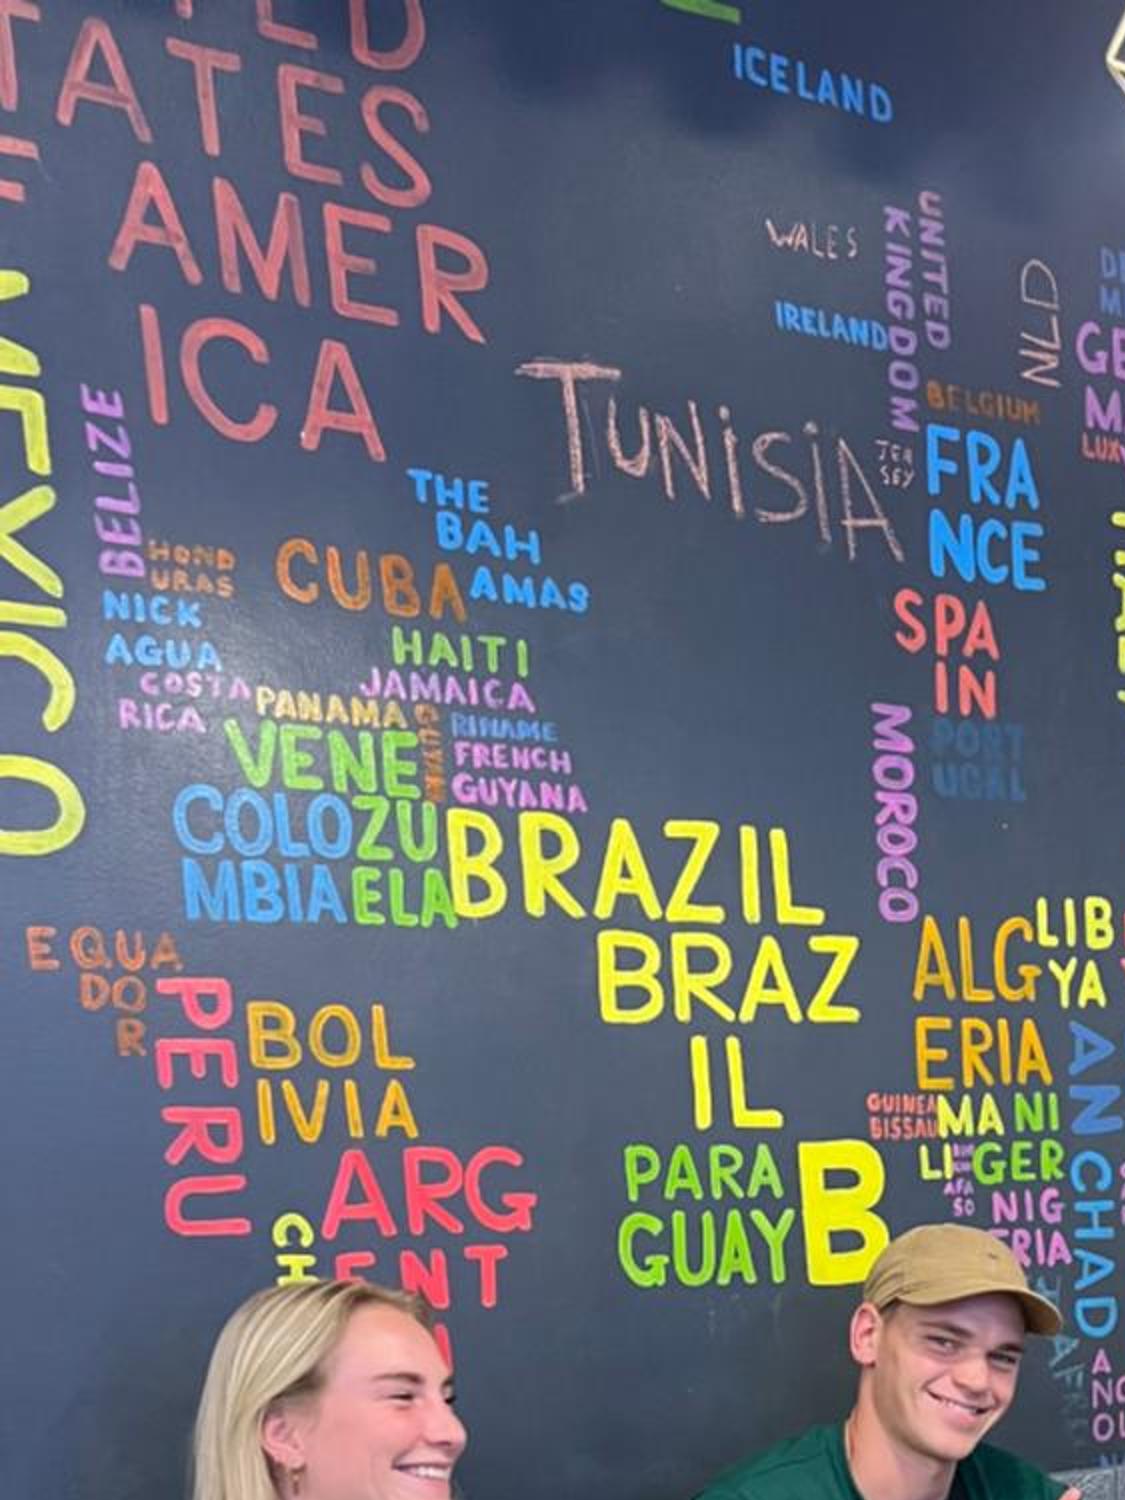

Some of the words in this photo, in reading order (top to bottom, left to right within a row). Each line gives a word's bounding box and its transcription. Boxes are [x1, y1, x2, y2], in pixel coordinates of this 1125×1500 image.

[733, 43, 893, 123] ICELAND
[109, 160, 489, 345] AMER
[766, 219, 858, 260] WALES
[918, 190, 951, 350] UNITED
[773, 301, 890, 352] IRELAND
[883, 205, 919, 433] KINGDOM
[141, 304, 386, 462] ICA
[926, 380, 1041, 424] BELGIUM
[80, 383, 147, 580] BELIZE
[407, 467, 490, 513] THE
[925, 423, 1038, 511] FRA
[147, 540, 236, 572] HOND
[436, 511, 541, 565] BAH
[929, 509, 1046, 592] NCE
[103, 590, 202, 629] NICK
[149, 572, 235, 601] URAS
[275, 537, 467, 623] CUBA
[470, 566, 591, 615] AMAS
[105, 632, 223, 672] AGUA
[391, 625, 529, 677] HAITI
[894, 588, 1000, 661] SPA
[118, 698, 206, 735] RICA
[140, 670, 252, 699] COSTA
[255, 686, 408, 730] PANAMA
[359, 666, 536, 714] JAMAICA
[934, 662, 998, 721] IN
[223, 717, 421, 800] VENE
[454, 740, 573, 775] FRENCH
[172, 783, 354, 860] COLO
[451, 772, 588, 813] GUYANA
[871, 702, 919, 923] MOROCO
[351, 796, 440, 862] ZU
[180, 858, 349, 925] MBIA
[351, 865, 458, 929] ELA
[446, 807, 826, 926] BRAZIL
[25, 926, 183, 971] EQUA
[1035, 895, 1116, 951] LIB
[596, 929, 862, 1024] BRAZ
[912, 914, 1042, 1003] ALG
[1048, 956, 1108, 1010] YA
[246, 1001, 415, 1070] BOL
[913, 1016, 1054, 1091] ERIA
[153, 975, 252, 1237] PERU
[690, 1035, 785, 1131] IL
[866, 1093, 936, 1115] GUINEA
[1069, 1019, 1124, 1136] AN
[257, 1078, 419, 1145] IVIA
[935, 1092, 1005, 1139] MA
[1013, 1090, 1061, 1132] NI
[321, 1145, 538, 1240] ARG
[622, 1144, 784, 1202] PARA
[972, 1138, 1065, 1186] GER
[991, 1187, 1065, 1225] NIG
[617, 1208, 795, 1288] GUAY
[1070, 1150, 1120, 1341] CHAD
